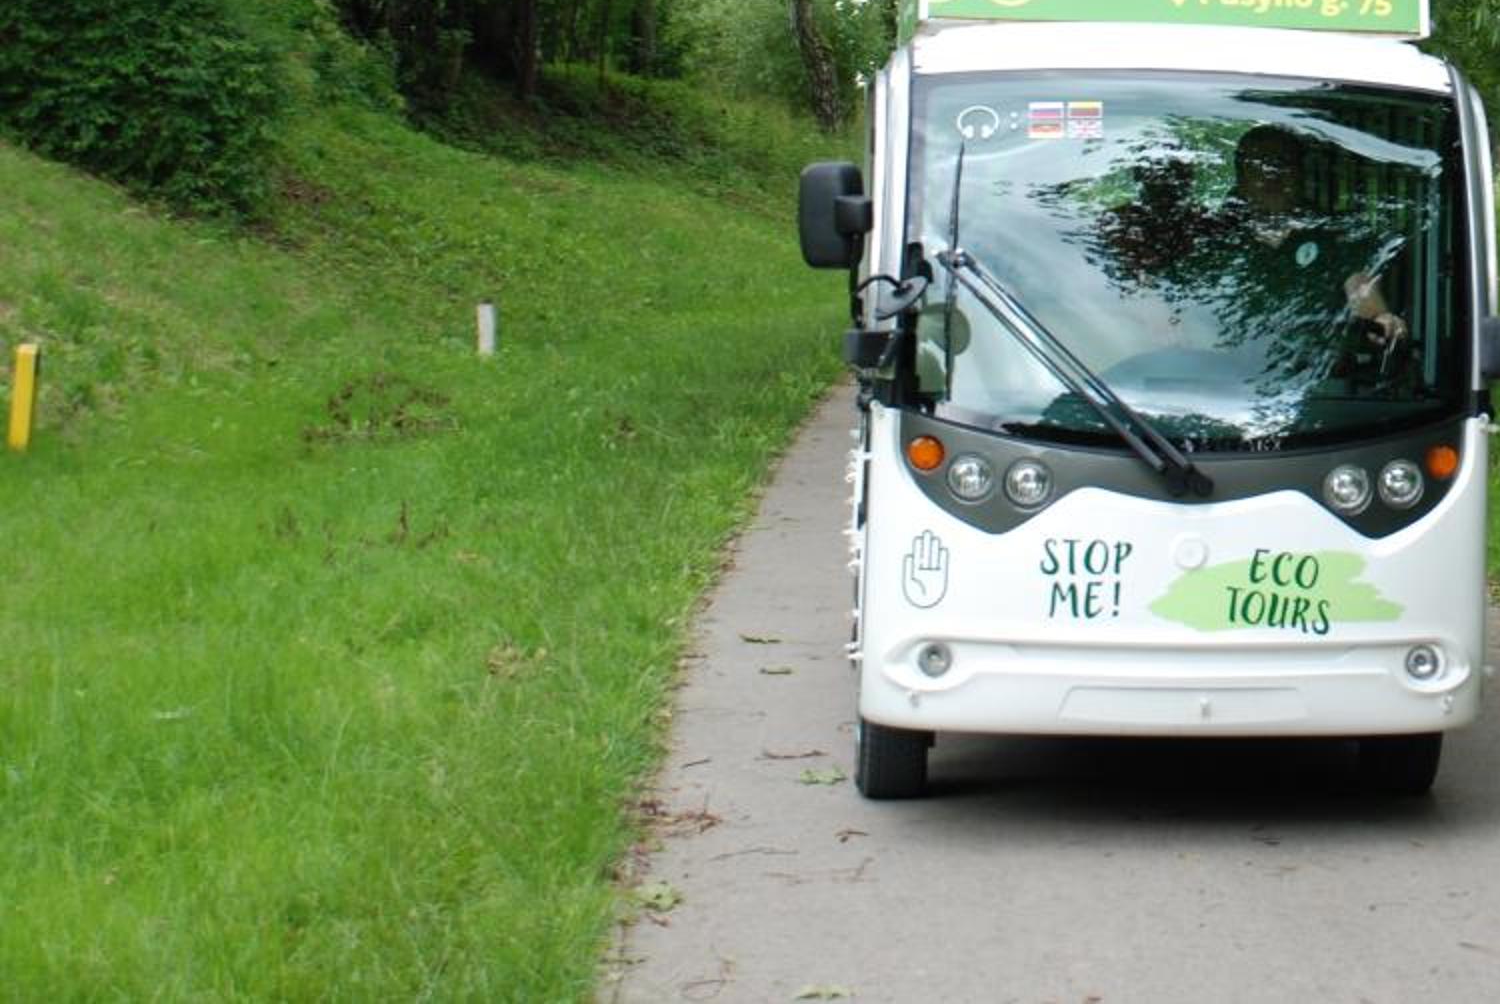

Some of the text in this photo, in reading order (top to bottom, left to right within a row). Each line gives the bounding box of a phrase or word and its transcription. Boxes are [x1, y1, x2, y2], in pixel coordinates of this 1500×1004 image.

[1040, 537, 1133, 576] STOP
[1249, 548, 1320, 589] ECO
[1049, 580, 1121, 619] ME!
[1226, 585, 1331, 635] TOURS
